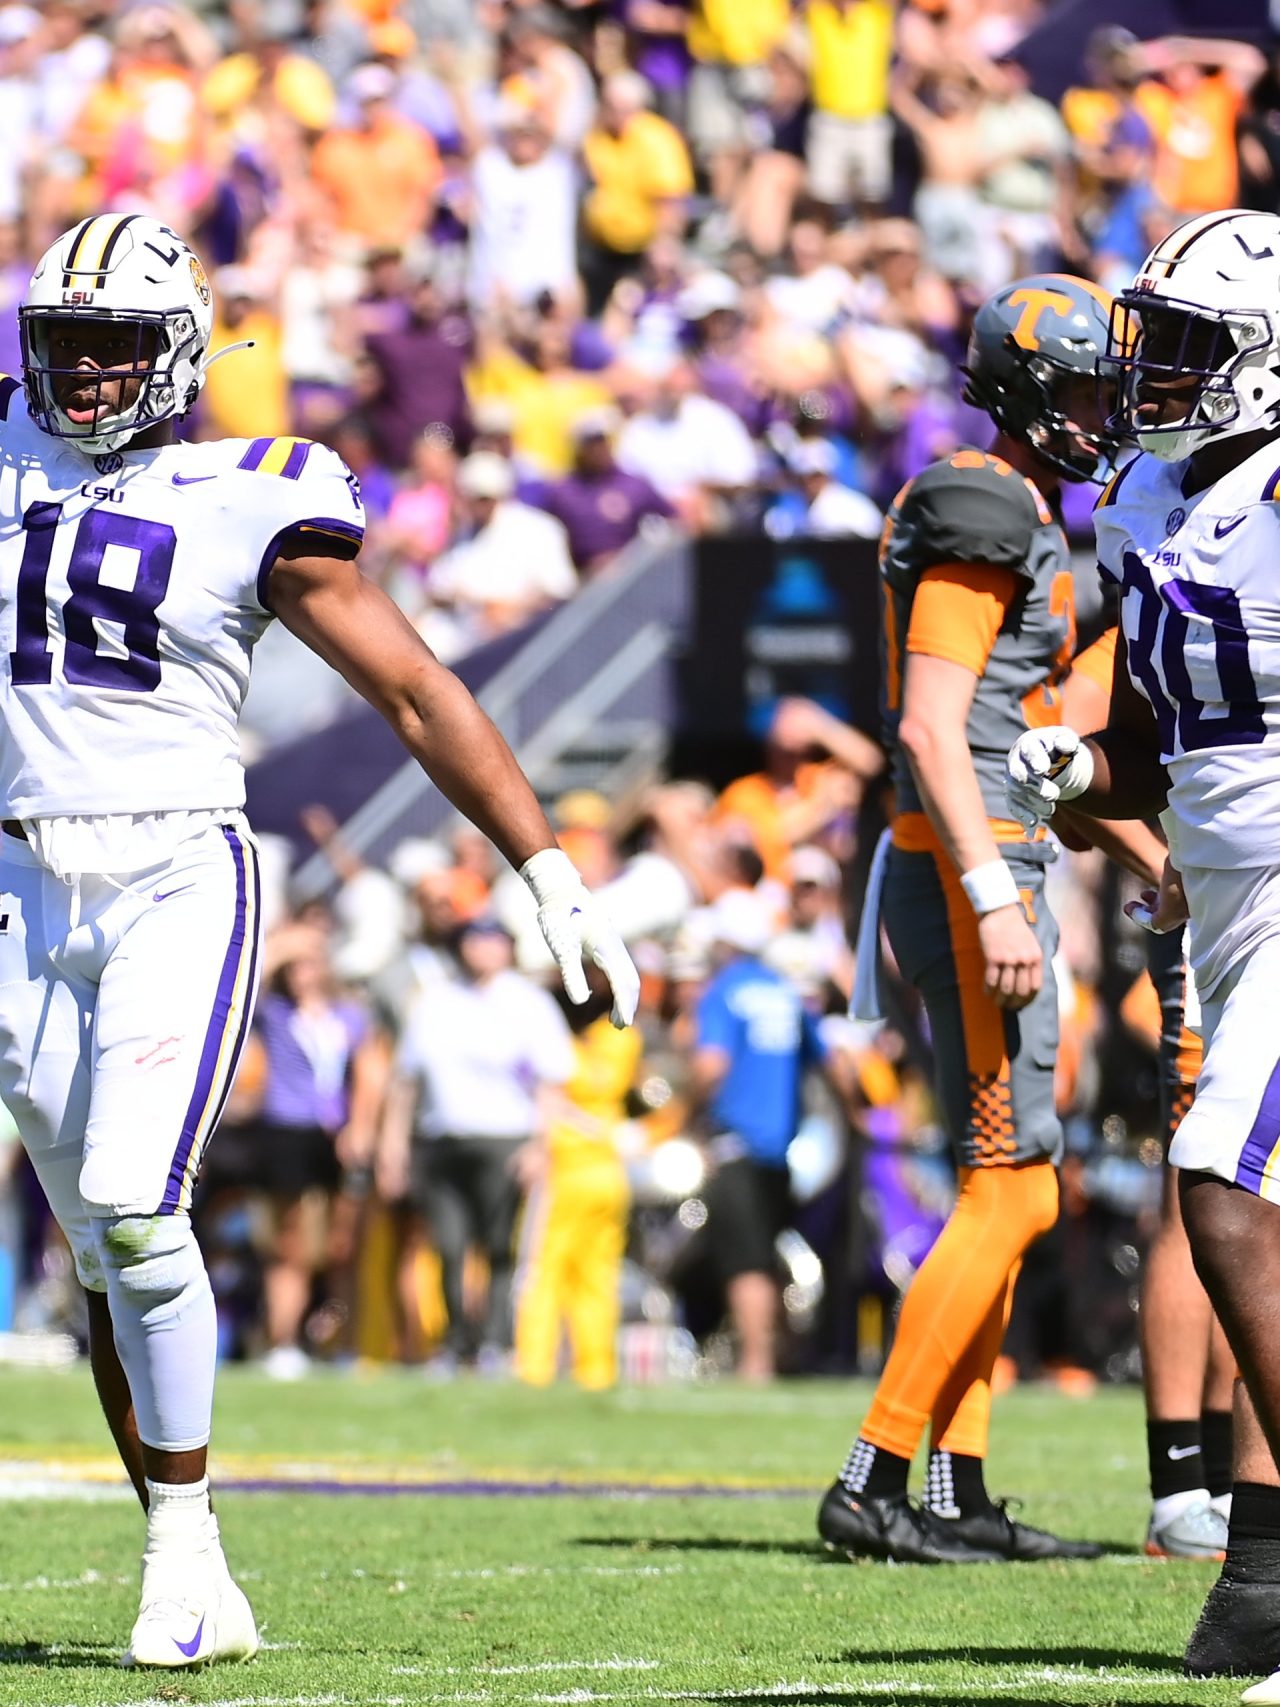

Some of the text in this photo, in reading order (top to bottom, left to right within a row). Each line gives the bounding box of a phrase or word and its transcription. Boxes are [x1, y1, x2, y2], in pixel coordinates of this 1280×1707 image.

[62, 291, 94, 305] LSU
[1008, 288, 1074, 351] T
[81, 484, 125, 503] LSU
[1152, 551, 1181, 567] LSU
[10, 501, 177, 692] 18
